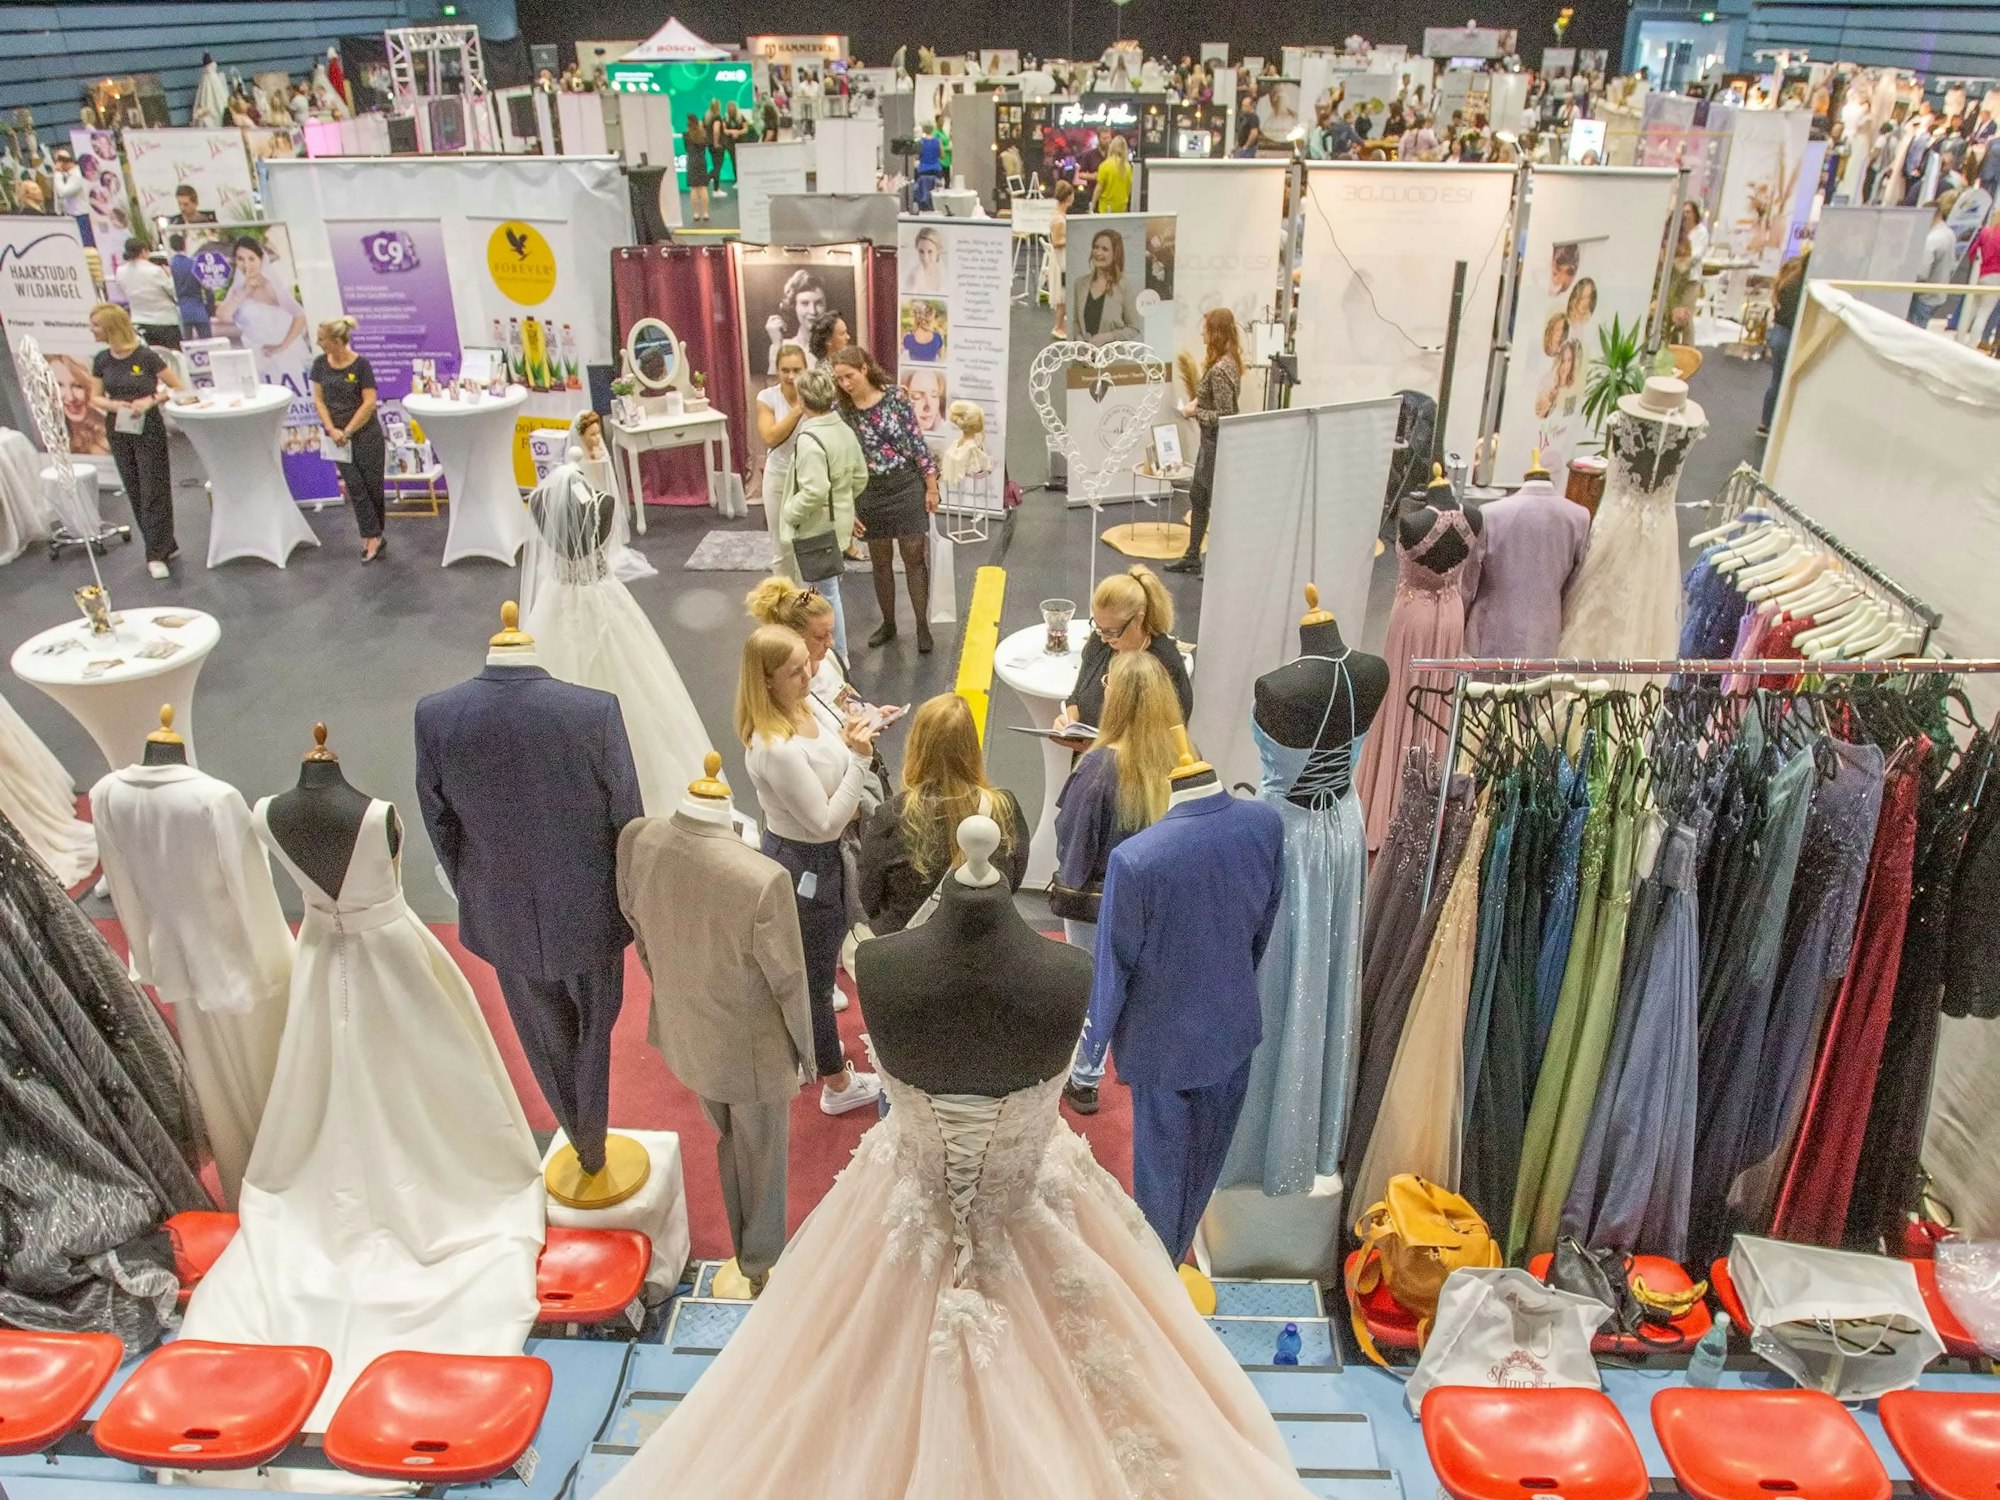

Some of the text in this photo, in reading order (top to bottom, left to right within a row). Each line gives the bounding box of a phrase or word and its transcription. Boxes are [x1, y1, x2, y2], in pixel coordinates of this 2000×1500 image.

[657, 45, 696, 53] BOSCH
[372, 237, 404, 265] C9
[9, 264, 78, 281] HAARSTUDIO
[14, 282, 82, 299] WILDANGEL
